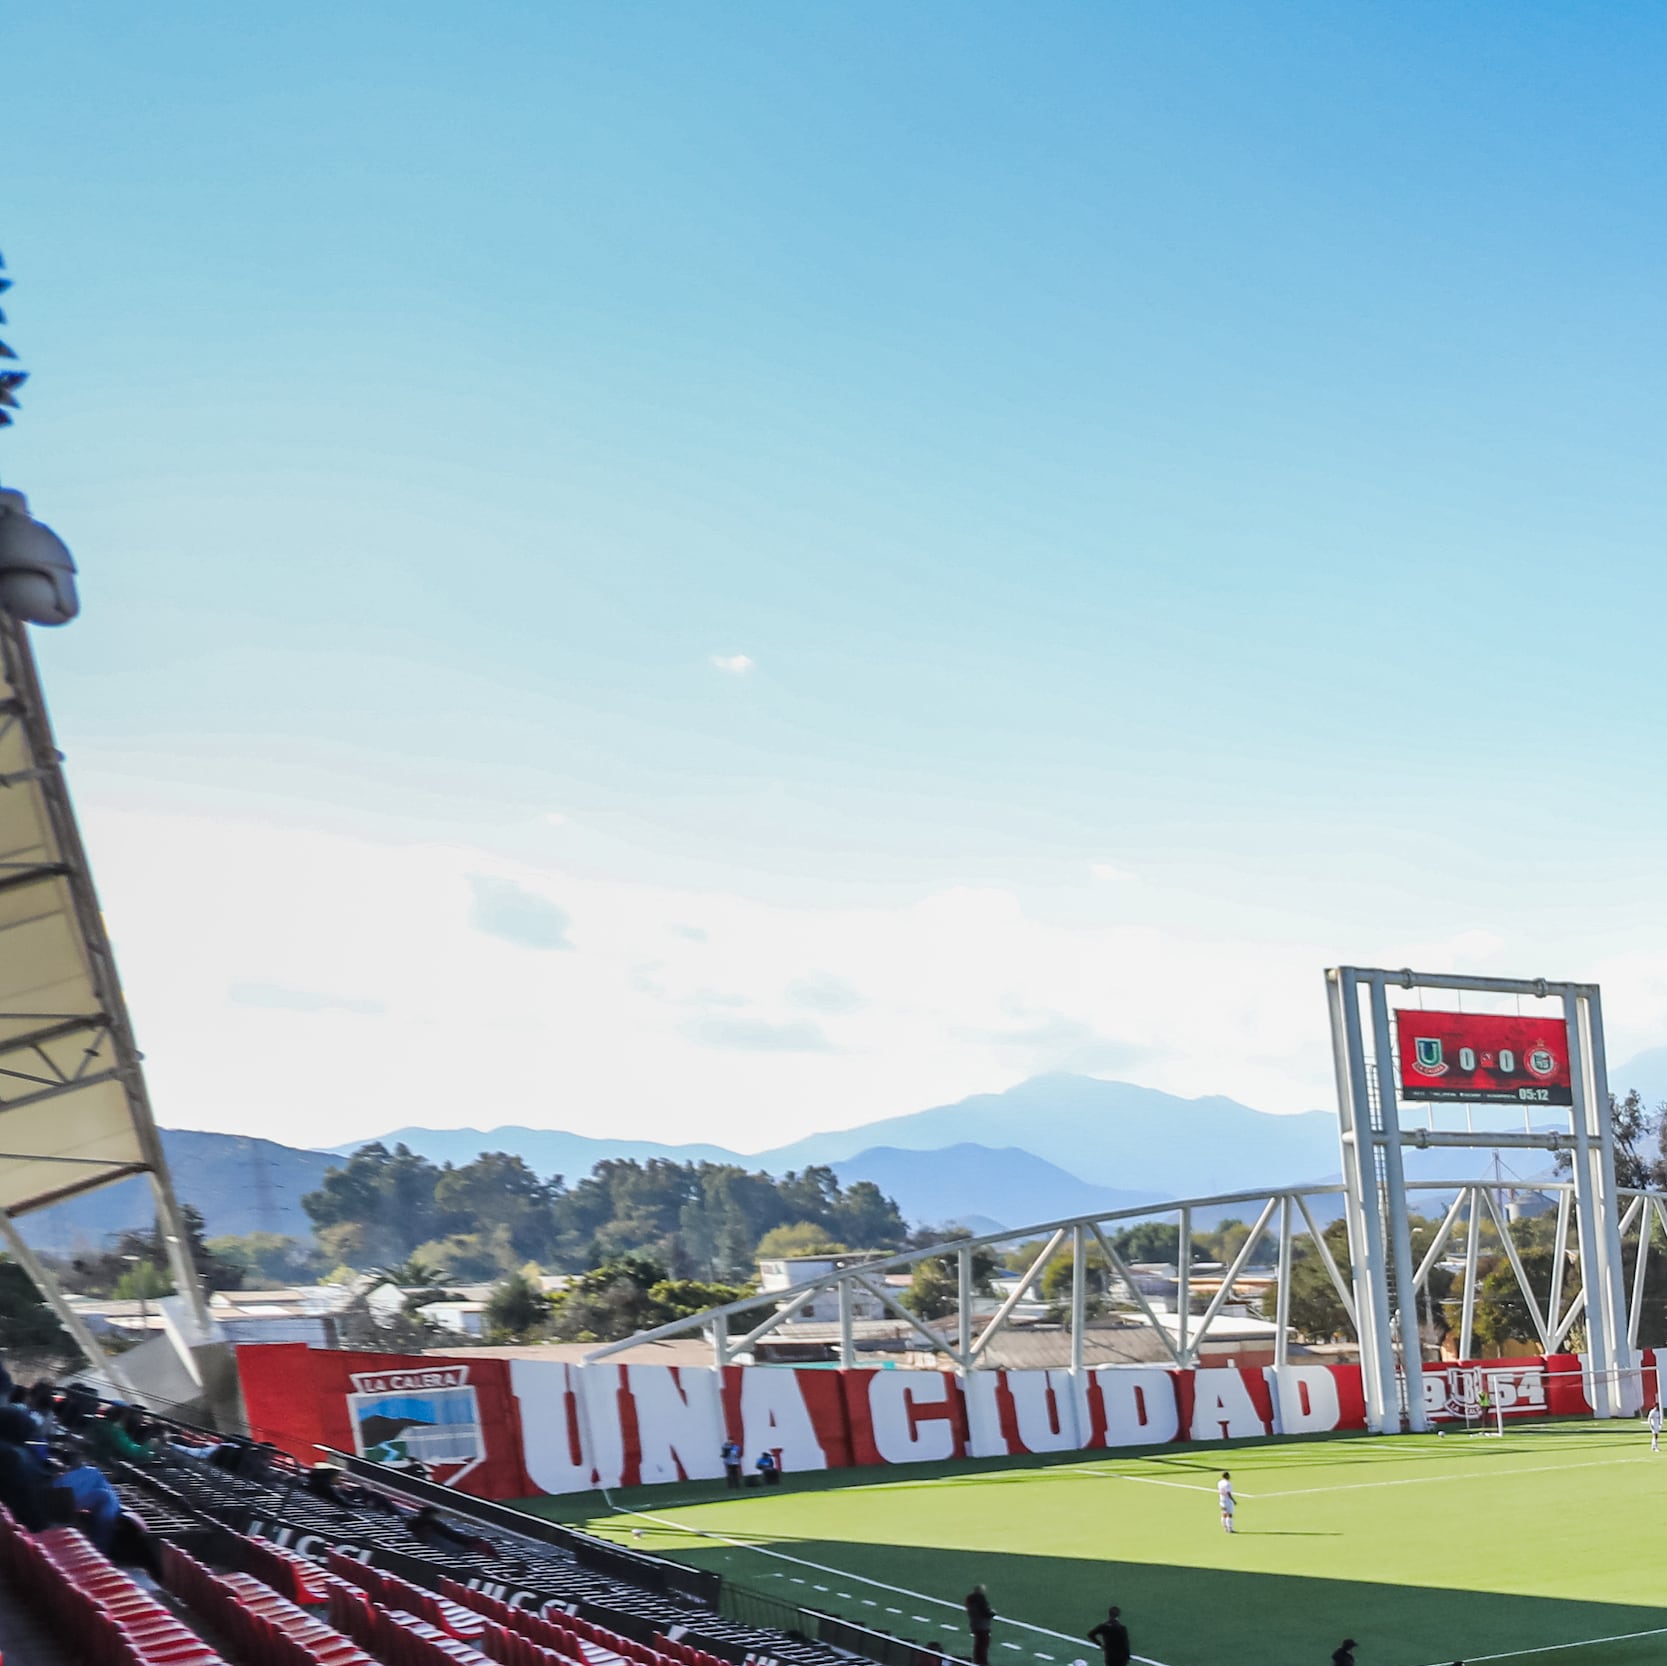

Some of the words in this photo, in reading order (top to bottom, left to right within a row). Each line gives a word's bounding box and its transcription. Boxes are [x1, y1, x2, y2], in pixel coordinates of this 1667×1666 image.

[1459, 1047, 1475, 1071] 0
[1499, 1049, 1514, 1072] 0
[1519, 1088, 1549, 1101] 05:12
[364, 1379, 387, 1393] LA
[390, 1373, 457, 1390] CALERA
[509, 1358, 827, 1495] UNA
[868, 1364, 1340, 1465] CIUDAD
